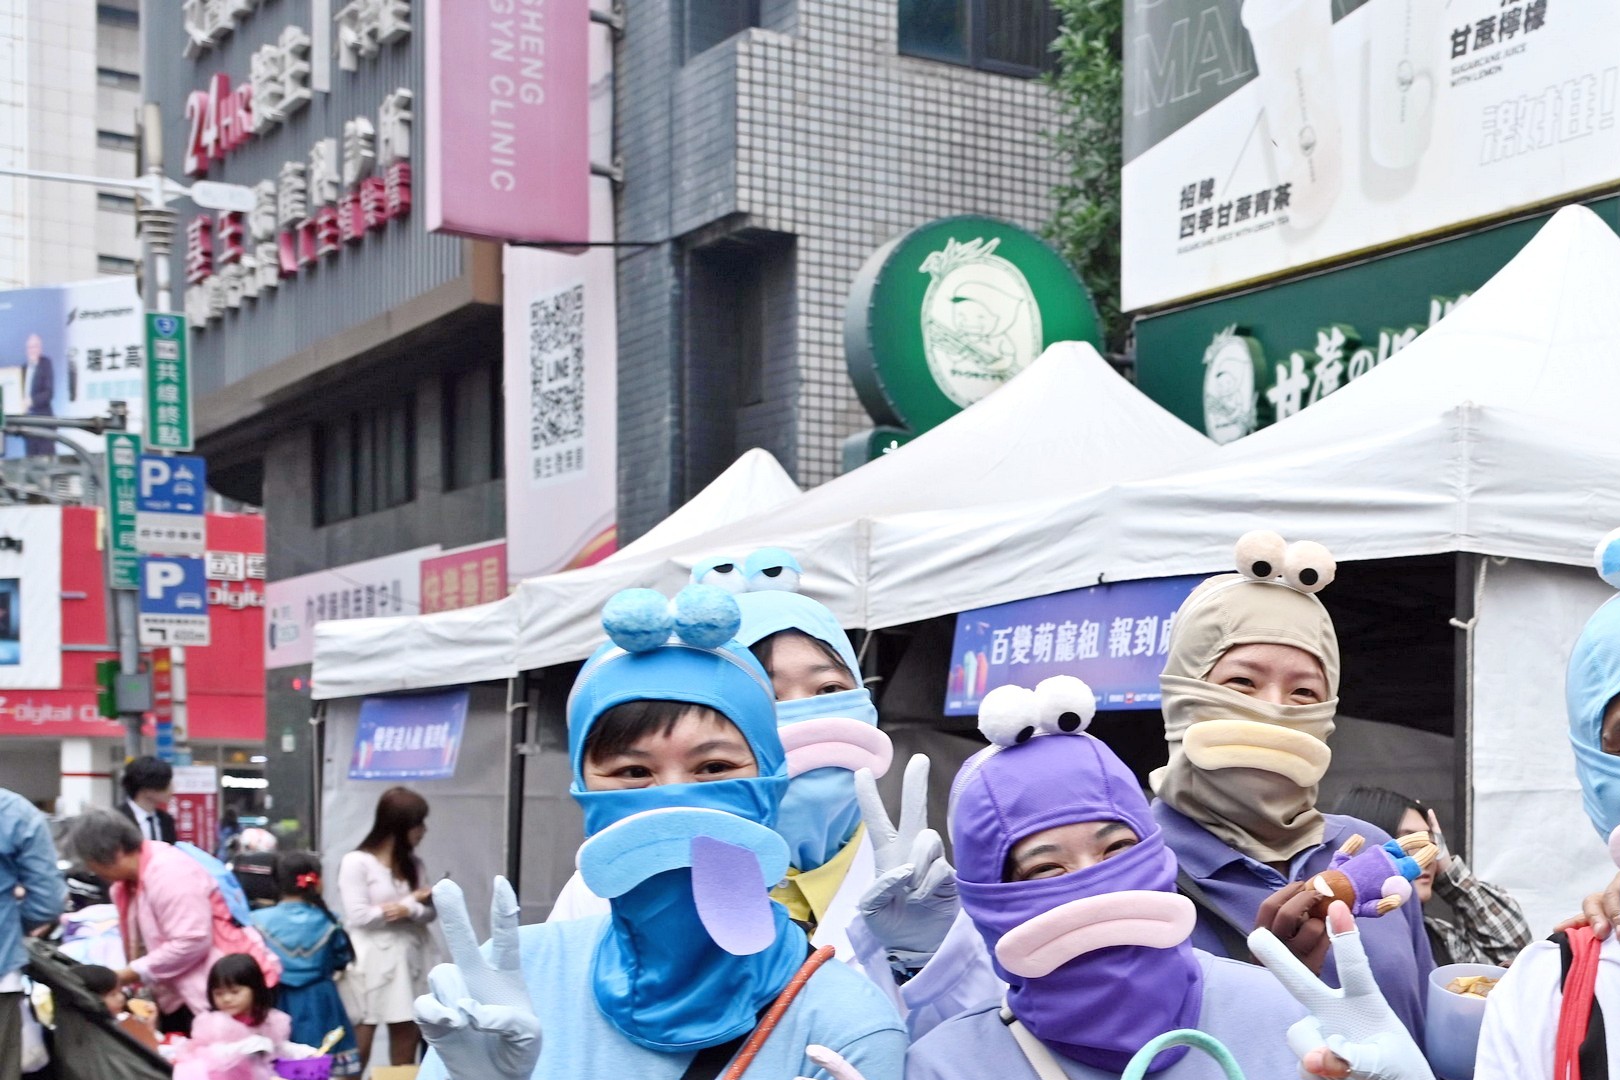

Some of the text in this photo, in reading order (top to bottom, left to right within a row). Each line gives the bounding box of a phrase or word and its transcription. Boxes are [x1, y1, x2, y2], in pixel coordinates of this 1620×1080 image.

[489, 74, 517, 192] CLINIC
[546, 354, 570, 384] LINE
[141, 459, 171, 498] P
[146, 561, 185, 600] P
[990, 619, 1100, 666] 百變萌寵組
